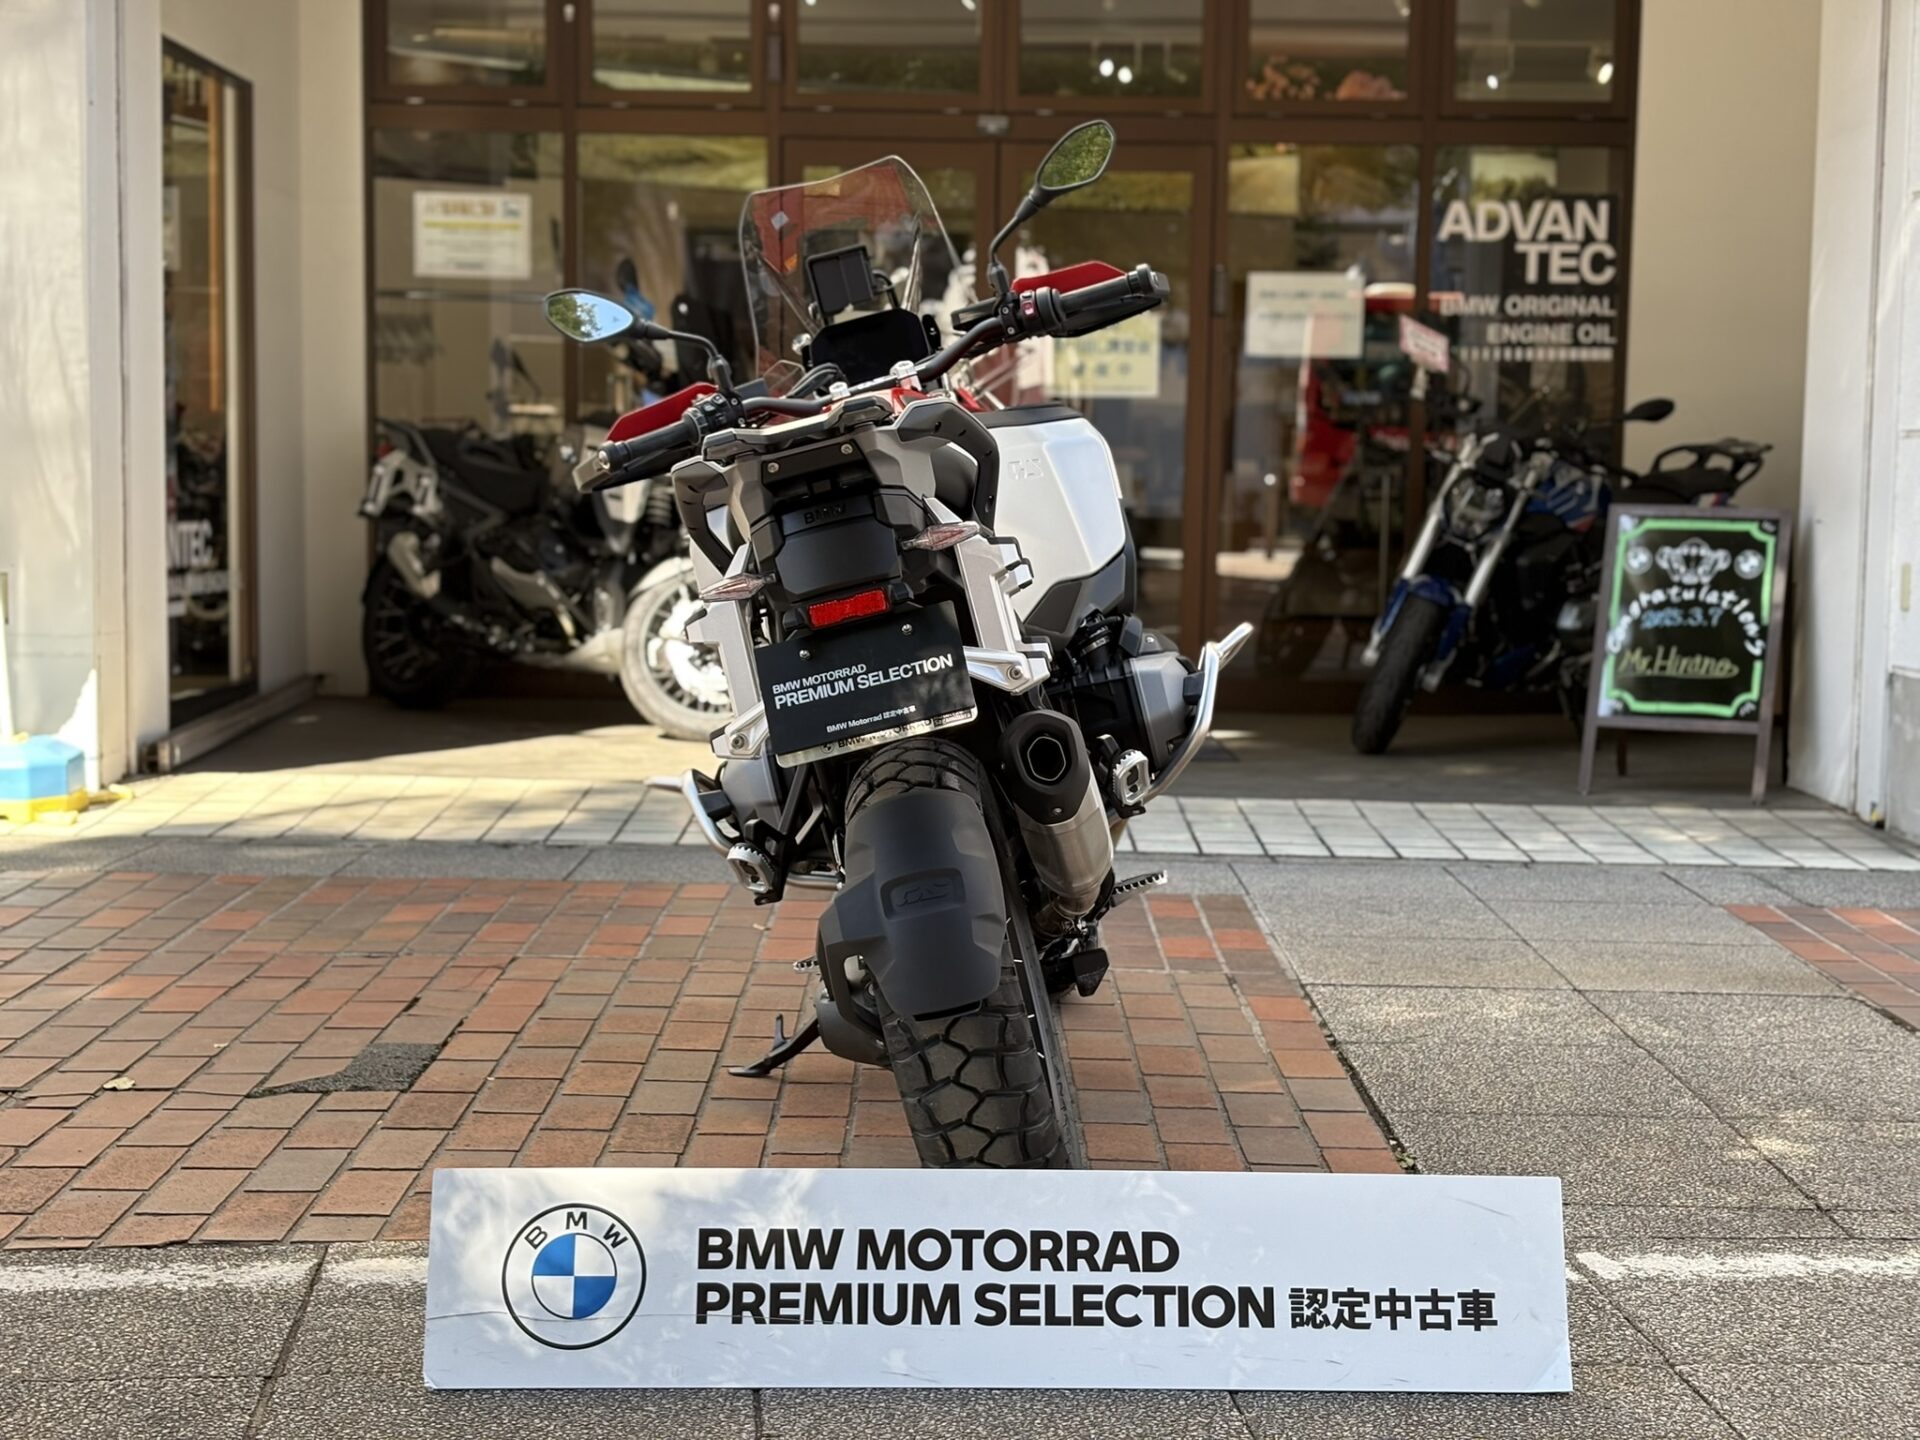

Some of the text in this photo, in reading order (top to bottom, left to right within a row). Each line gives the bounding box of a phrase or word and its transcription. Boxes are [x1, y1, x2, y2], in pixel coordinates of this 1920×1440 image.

[1437, 199, 1610, 242] ADVAN
[1515, 242, 1617, 285] TEC
[1440, 294, 1616, 317] BMW ORIGINAL
[1486, 322, 1617, 344] ENGINE OIL
[772, 663, 867, 694] BMW MOTORRAD
[774, 653, 954, 709] PREMIUM SELECTION
[826, 721, 848, 733] BMW
[848, 713, 883, 728] Motorrad
[524, 1211, 629, 1251] BMW
[698, 1228, 1180, 1273] BMW MOTORRAD
[696, 1282, 1499, 1332] PREMIUM SELECTION 認定中古車
